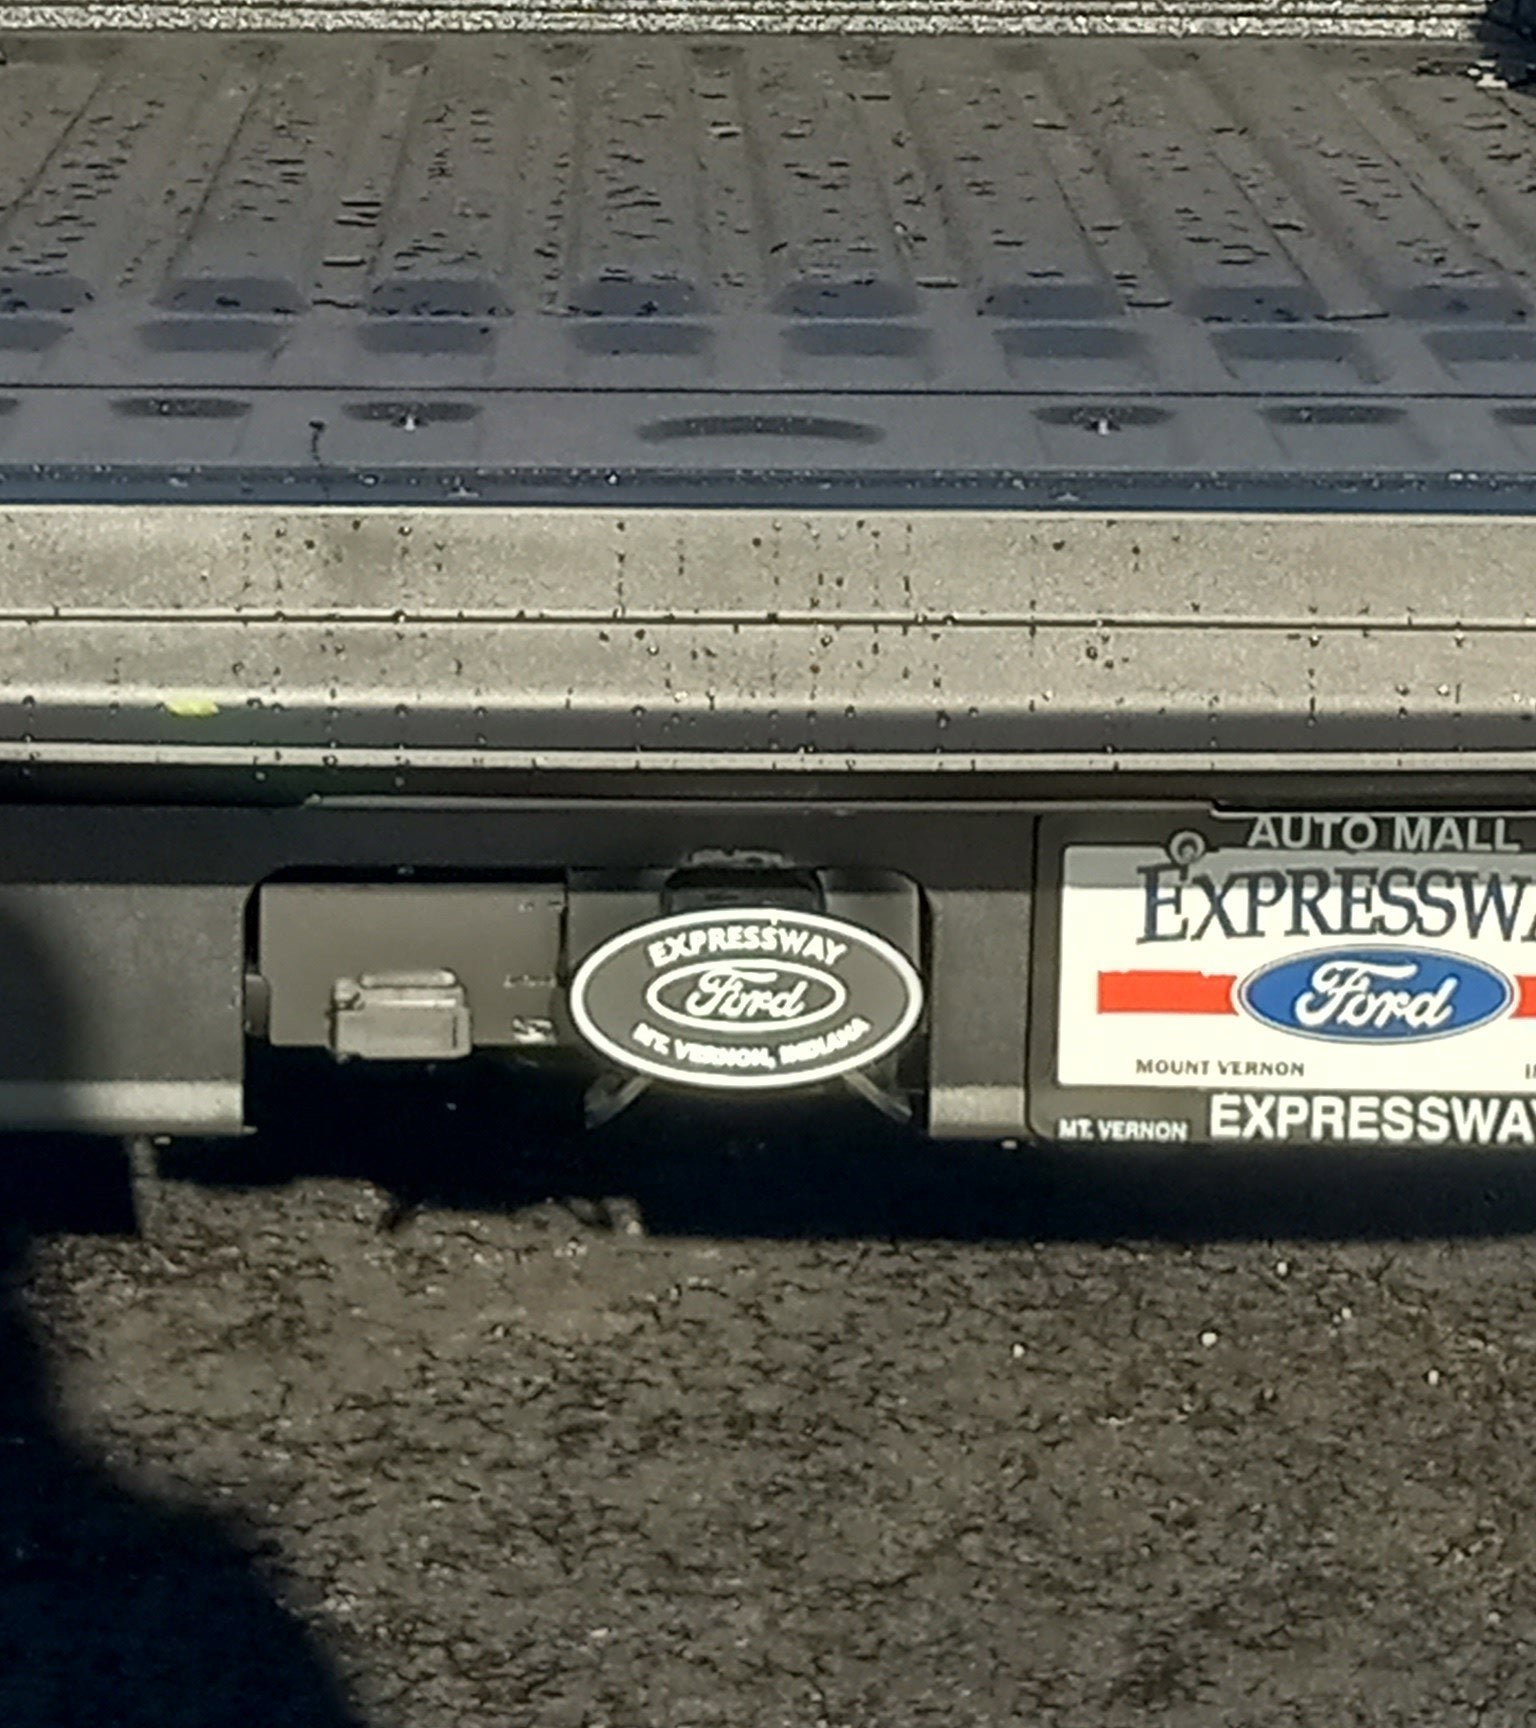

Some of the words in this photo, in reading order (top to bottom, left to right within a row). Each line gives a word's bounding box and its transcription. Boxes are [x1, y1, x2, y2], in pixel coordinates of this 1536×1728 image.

[1247, 815, 1378, 850] AUTO
[1393, 816, 1521, 852] MALL
[648, 925, 847, 967] EXPRESSWAY
[686, 969, 808, 1018] Ford
[1294, 960, 1458, 1028] Ford
[778, 1017, 871, 1064] INDIANA
[1135, 1057, 1210, 1076] MOUNT
[1217, 1059, 1305, 1078] VERNON
[1059, 1118, 1095, 1140] MT.
[1099, 1120, 1188, 1142] VERNON
